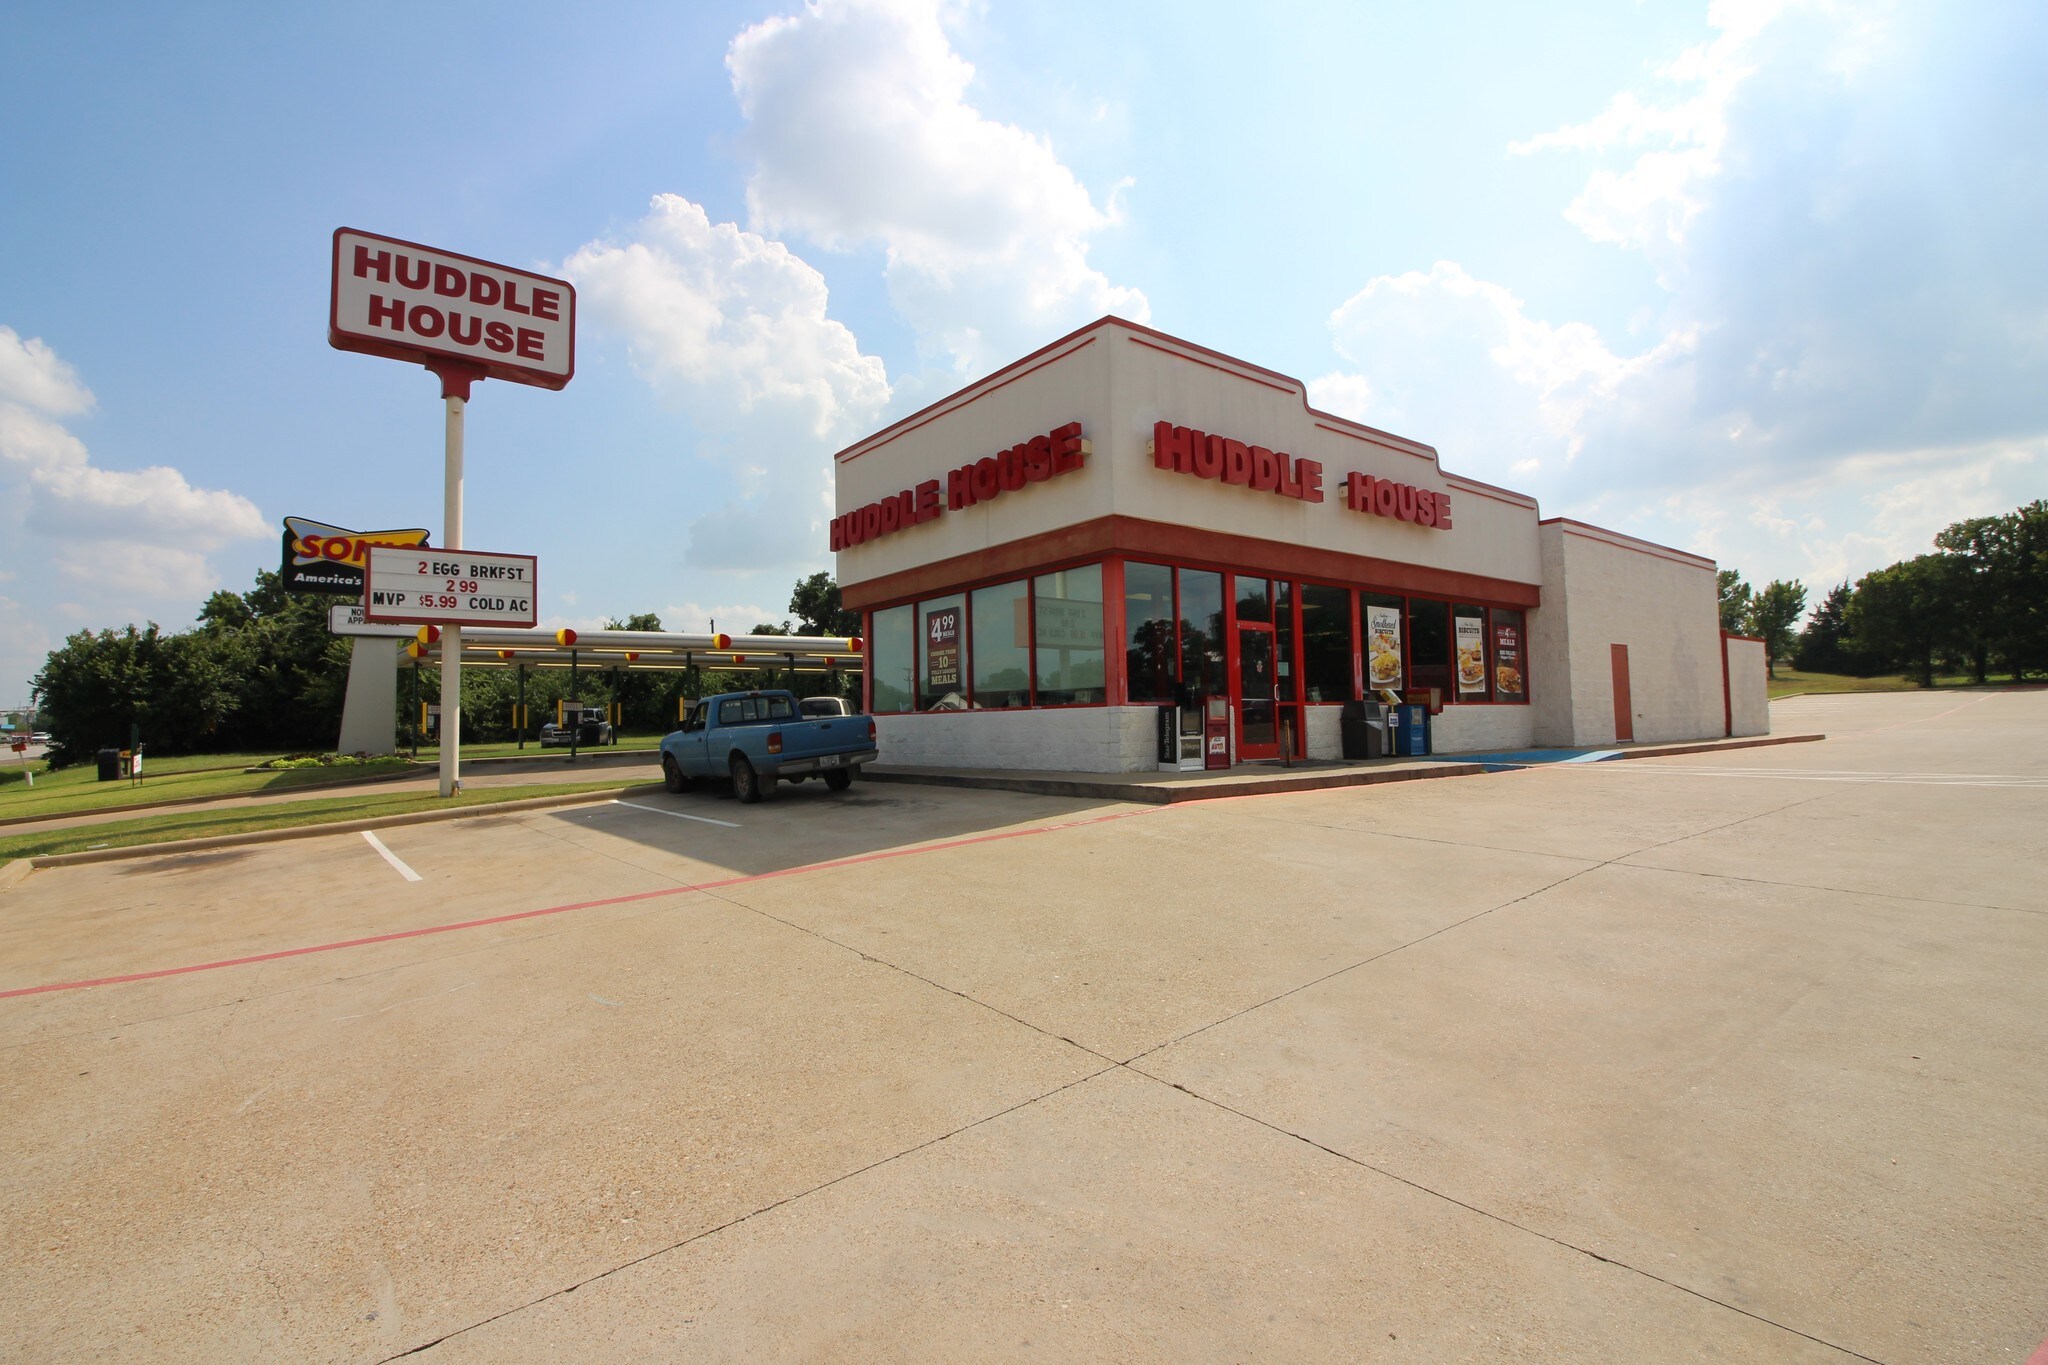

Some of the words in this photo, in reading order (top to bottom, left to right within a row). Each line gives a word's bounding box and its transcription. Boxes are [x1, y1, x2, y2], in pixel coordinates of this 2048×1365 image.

[353, 245, 560, 322] HUDDLE
[368, 294, 545, 361] HOUSE
[1154, 420, 1323, 503] HUDDLE
[1347, 471, 1452, 530] HOUSE
[830, 480, 941, 552] HUDDLE
[948, 421, 1083, 511] HOUSE
[298, 534, 418, 561] SON
[294, 572, 362, 586] America's
[418, 561, 428, 575] 2
[432, 562, 460, 576] EGG
[470, 565, 524, 580] BRKFST
[446, 579, 455, 592] 2
[459, 580, 478, 593] 99
[373, 592, 405, 606] MVP
[419, 595, 457, 609] $5.99
[469, 597, 504, 611] COLD
[509, 599, 528, 612] AC
[347, 616, 364, 624] APP
[938, 656, 949, 668] 10
[931, 674, 957, 685] MEALS
